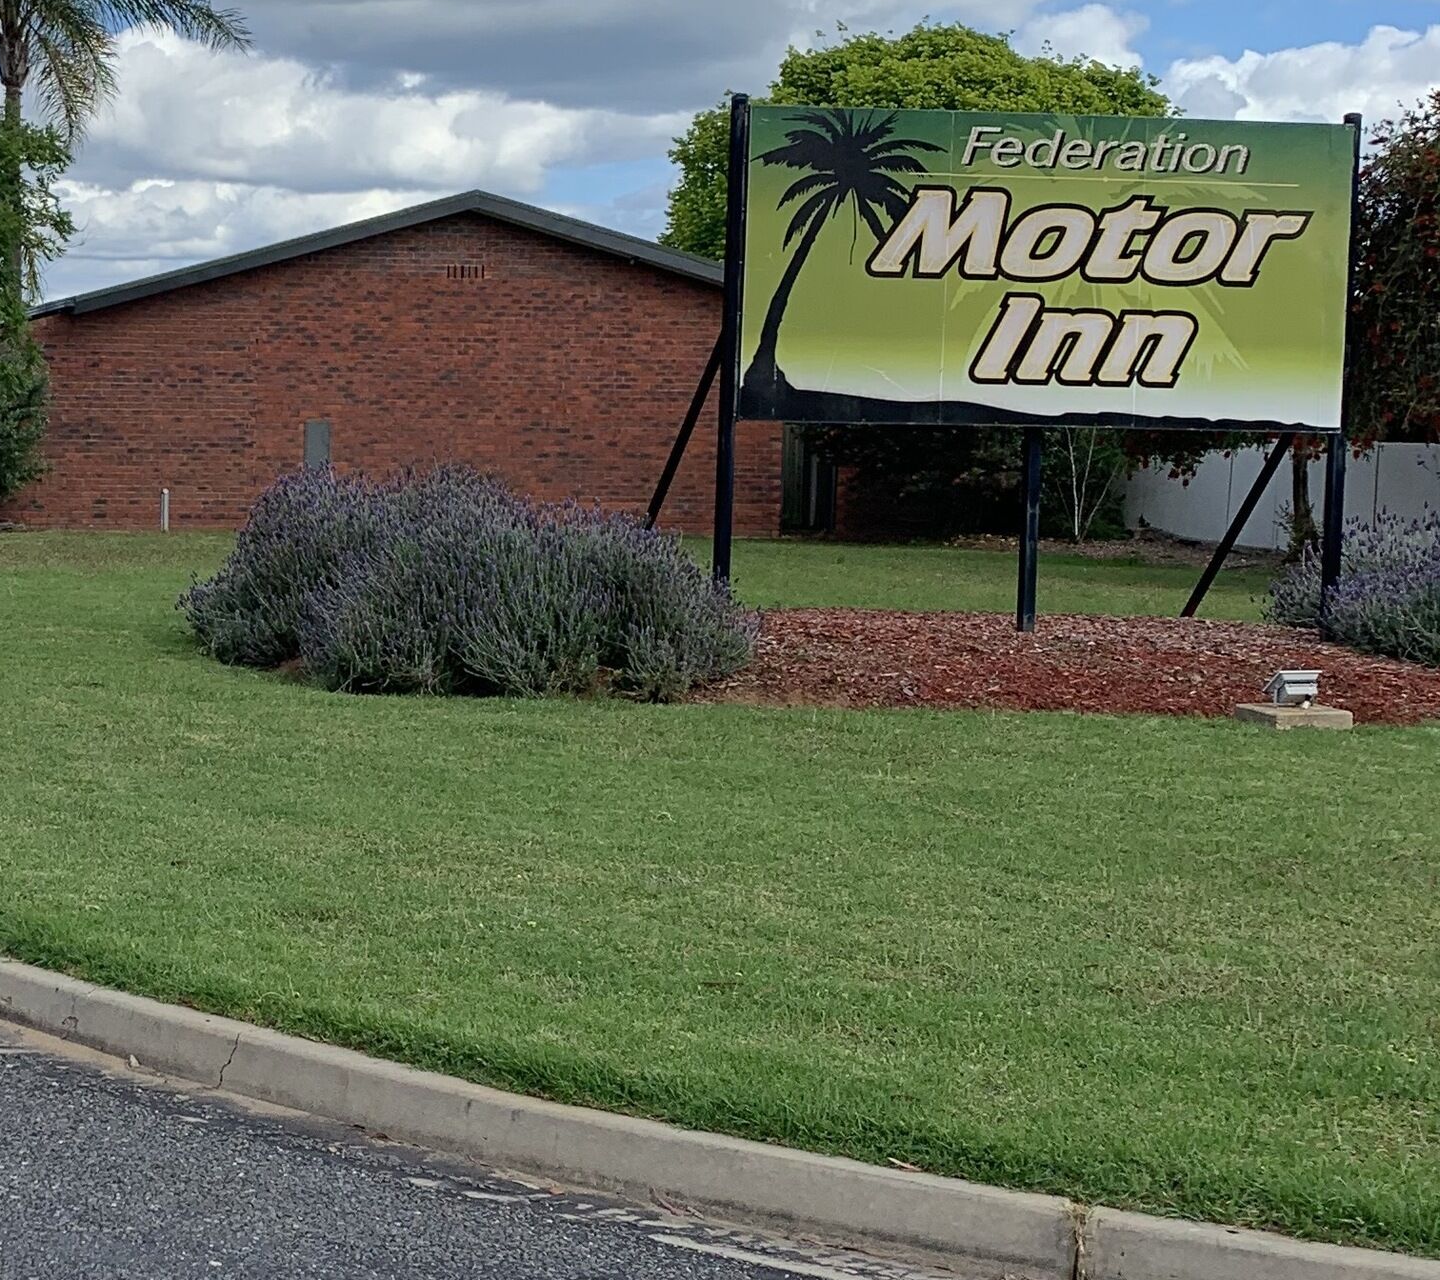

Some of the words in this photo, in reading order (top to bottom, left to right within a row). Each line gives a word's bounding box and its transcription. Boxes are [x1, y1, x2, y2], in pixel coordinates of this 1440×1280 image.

[961, 125, 1250, 173] Federation
[866, 185, 1313, 287] Motor
[969, 292, 1198, 388] Inn
